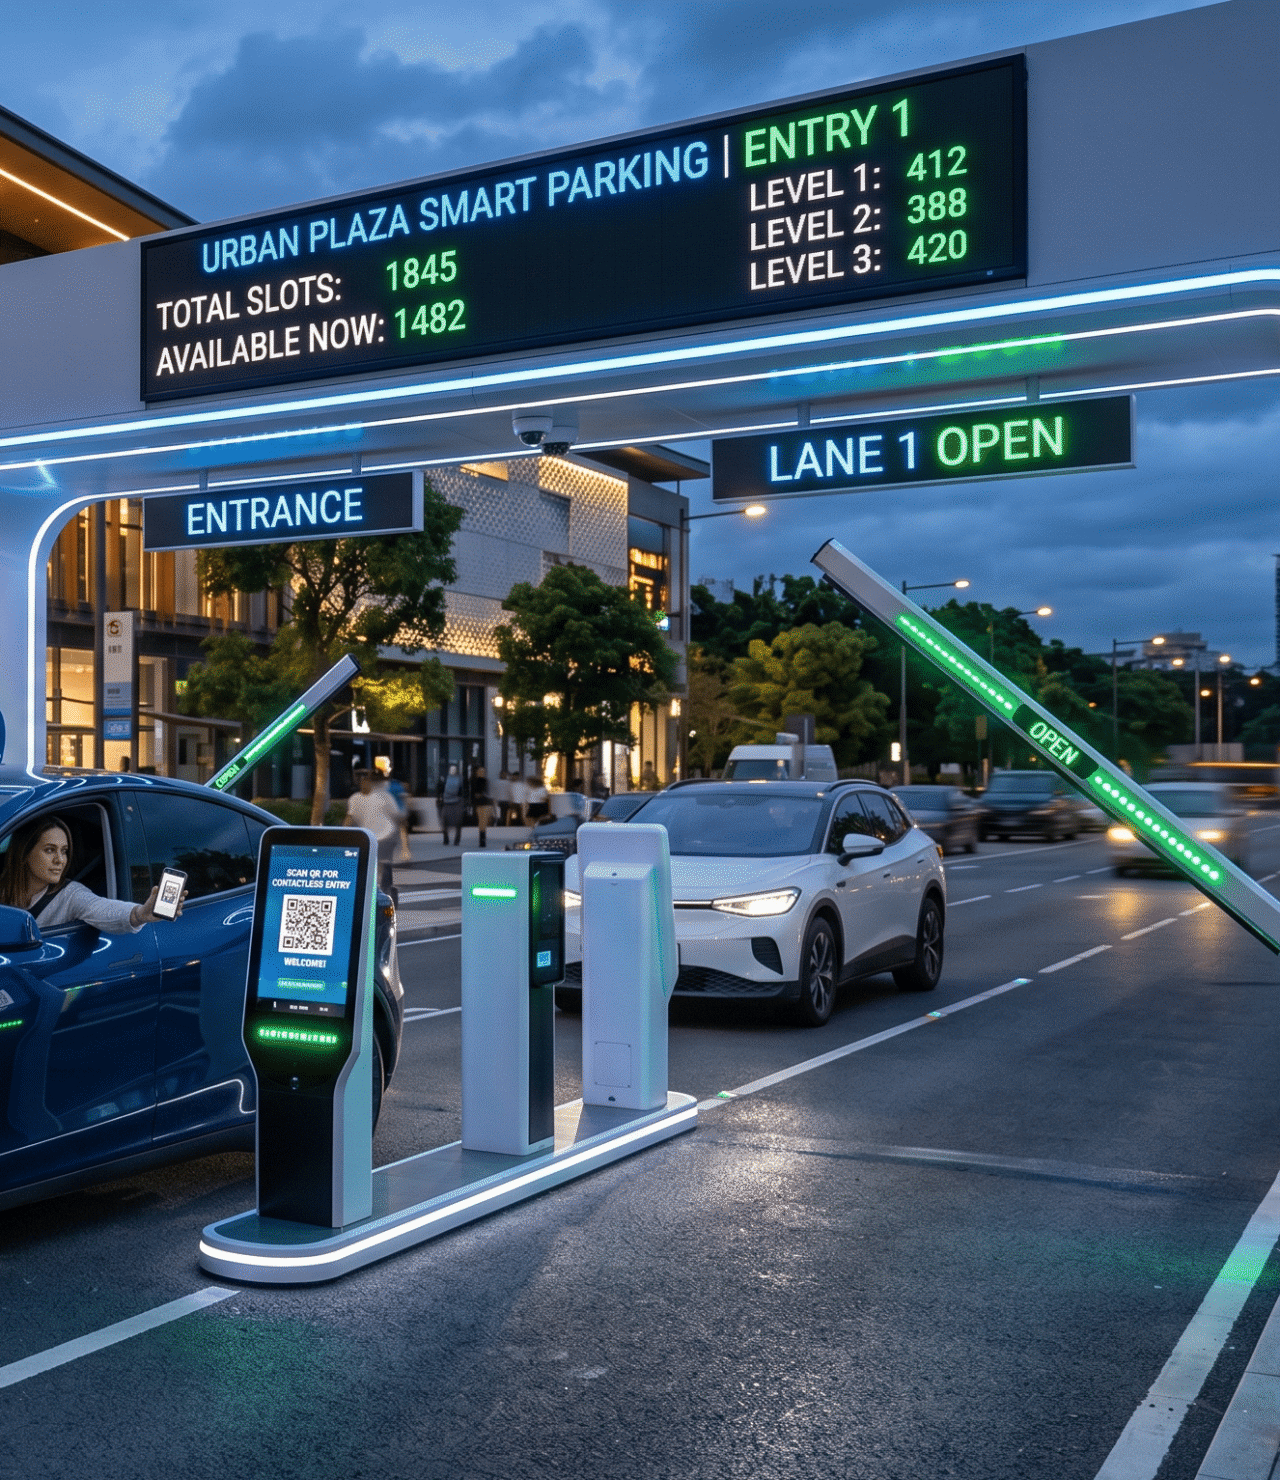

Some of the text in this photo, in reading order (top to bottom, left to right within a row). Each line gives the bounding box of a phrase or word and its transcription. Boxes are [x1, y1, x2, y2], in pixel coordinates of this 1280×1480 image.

[745, 98, 908, 168] ENTRY 1
[202, 141, 709, 273] URBAN PLAZA SMART PARKING
[750, 145, 968, 212] LEVEL 1: 412
[750, 187, 968, 251] LEVEL 2: 388
[156, 250, 458, 331] TOTAL SLOTS: 1845
[750, 230, 968, 291] LEVEL 3: 420
[156, 299, 466, 377] AVAILABLE NOW: 1482
[770, 416, 1063, 482] LANE 1 OPEN
[187, 488, 363, 535] ENTRANCE
[1029, 722, 1079, 765] OPEN
[272, 879, 351, 889] CONTACTLESS ENTRY
